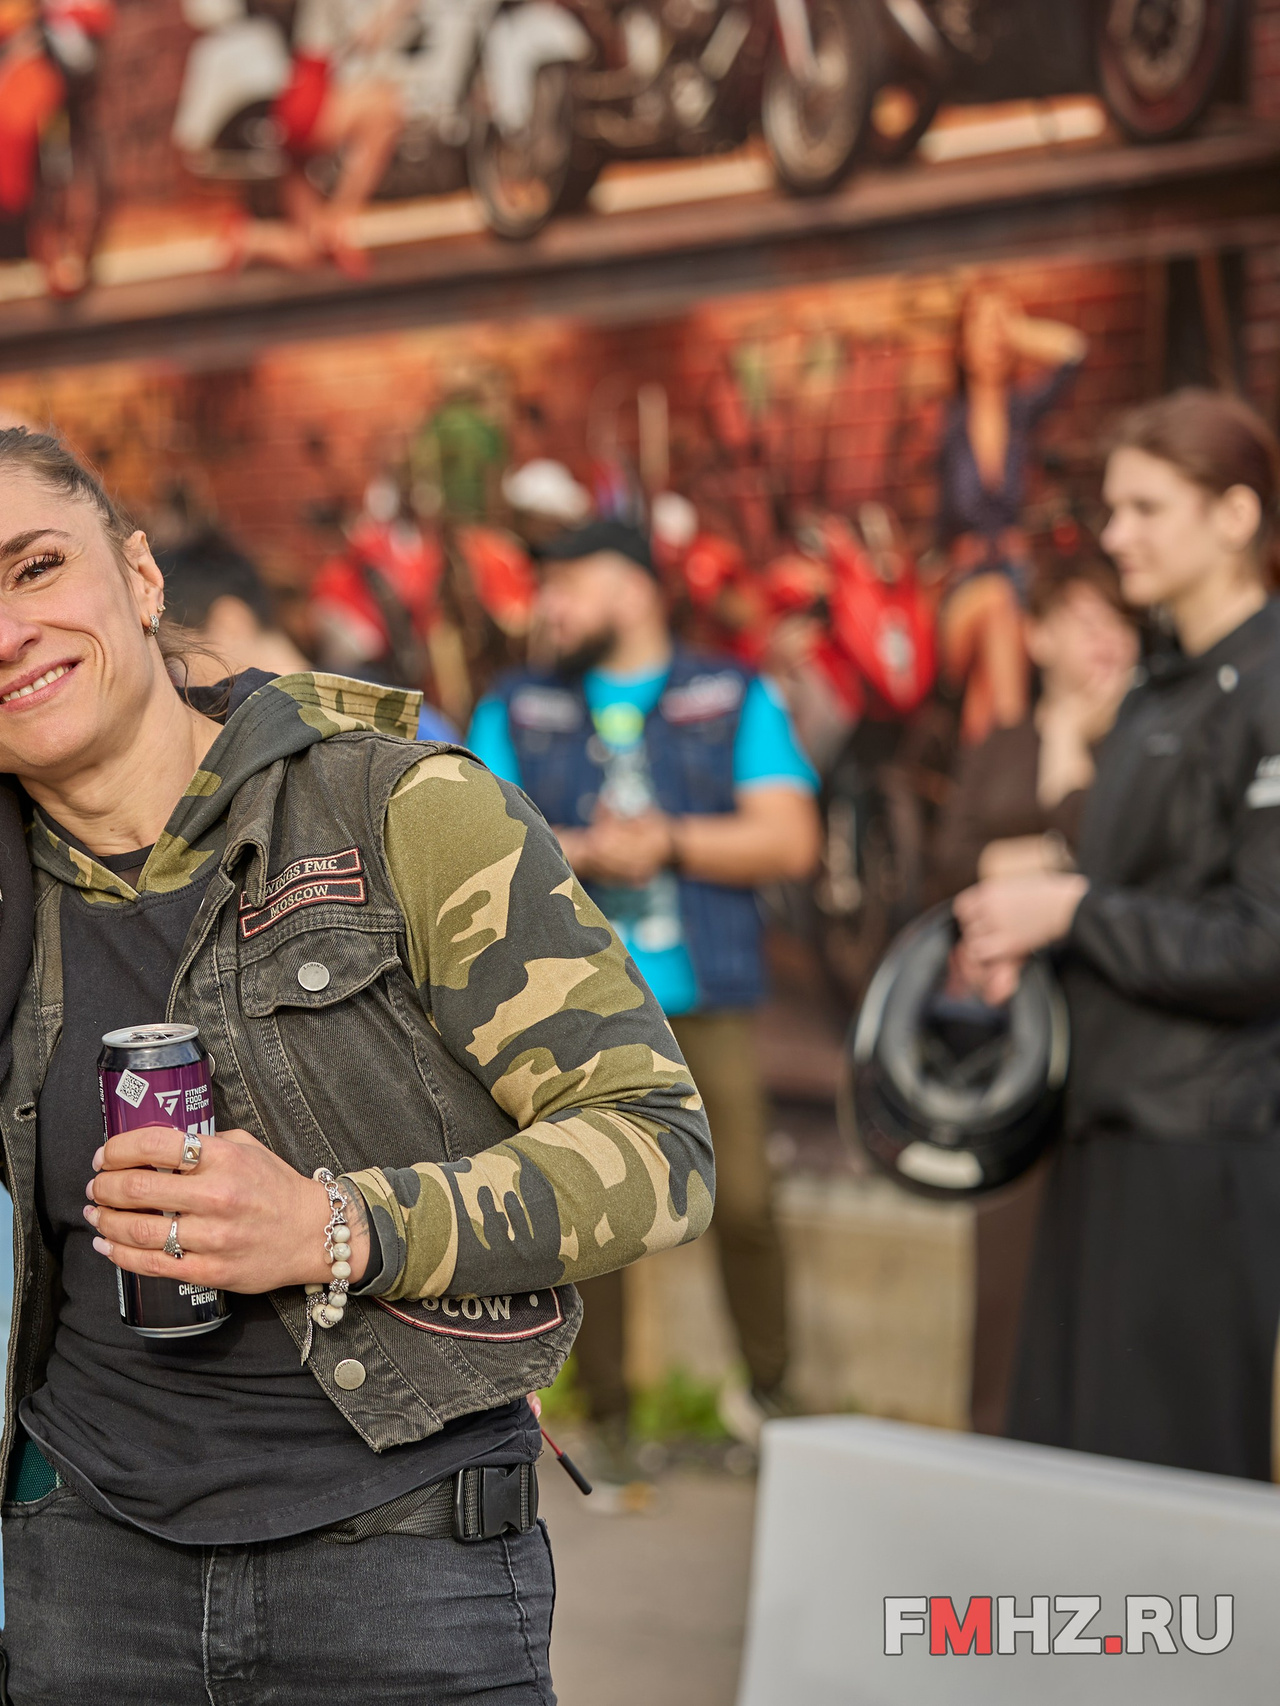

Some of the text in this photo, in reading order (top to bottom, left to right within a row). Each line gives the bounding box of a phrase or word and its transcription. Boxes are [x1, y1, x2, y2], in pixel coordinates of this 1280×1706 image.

[304, 859, 338, 873] FMC
[270, 884, 329, 918] MOSCOW
[184, 1084, 208, 1098] FITNESS
[185, 1094, 203, 1105] FOOD
[186, 1098, 210, 1112] FACTORY
[191, 1290, 218, 1306] ENERGY
